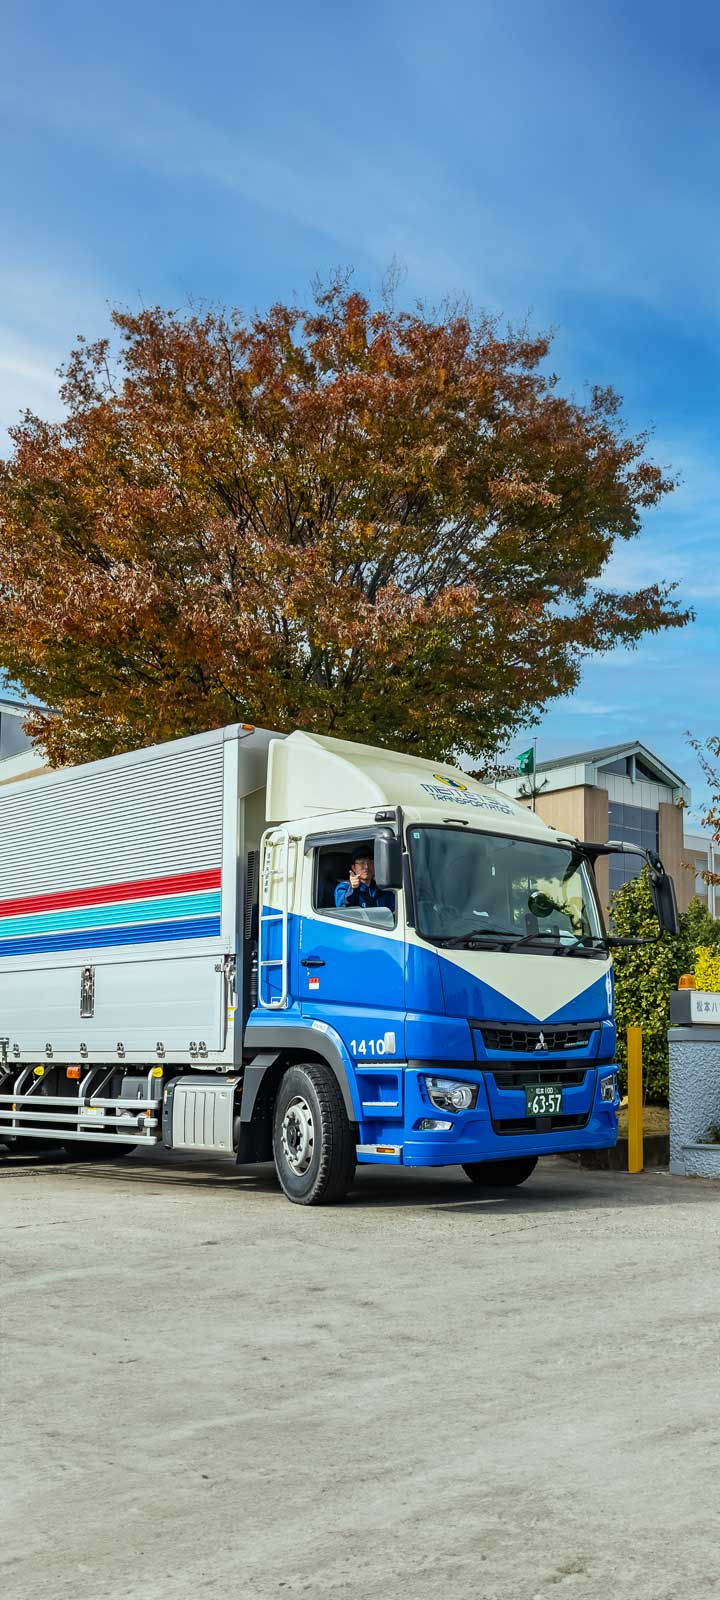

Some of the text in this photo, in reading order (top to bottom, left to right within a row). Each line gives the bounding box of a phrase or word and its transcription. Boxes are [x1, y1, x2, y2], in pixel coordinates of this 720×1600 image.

[696, 1000, 720, 1013] 松本ハ
[350, 1039, 385, 1056] 1410
